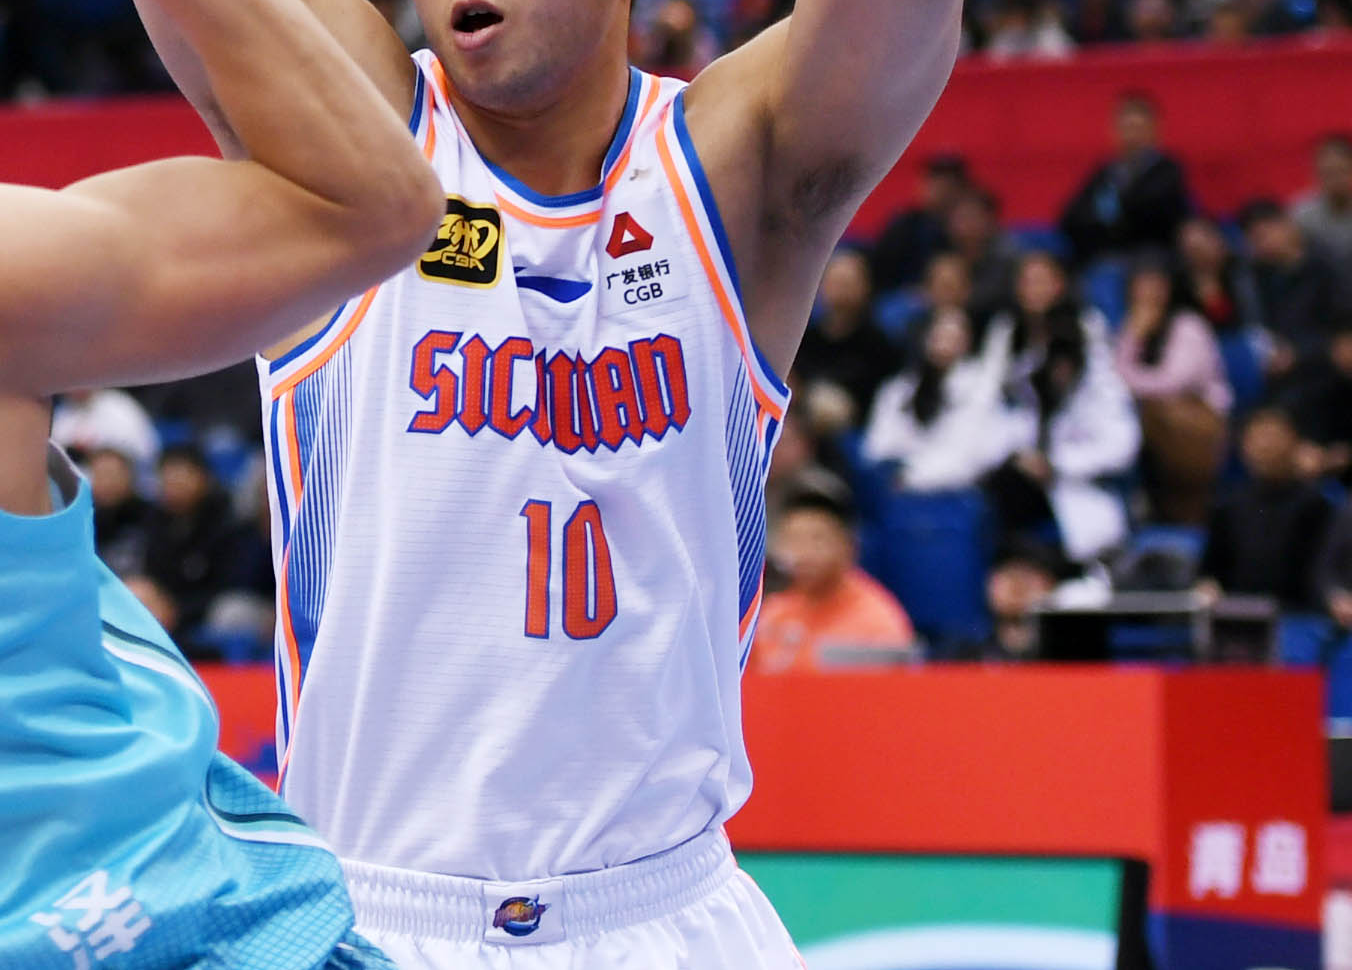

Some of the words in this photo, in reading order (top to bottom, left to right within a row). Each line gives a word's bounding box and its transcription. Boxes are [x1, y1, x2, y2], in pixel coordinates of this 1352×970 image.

[441, 250, 485, 271] CBA
[606, 259, 670, 289] 广发银行
[623, 283, 663, 305] CGB
[521, 499, 618, 640] 10
